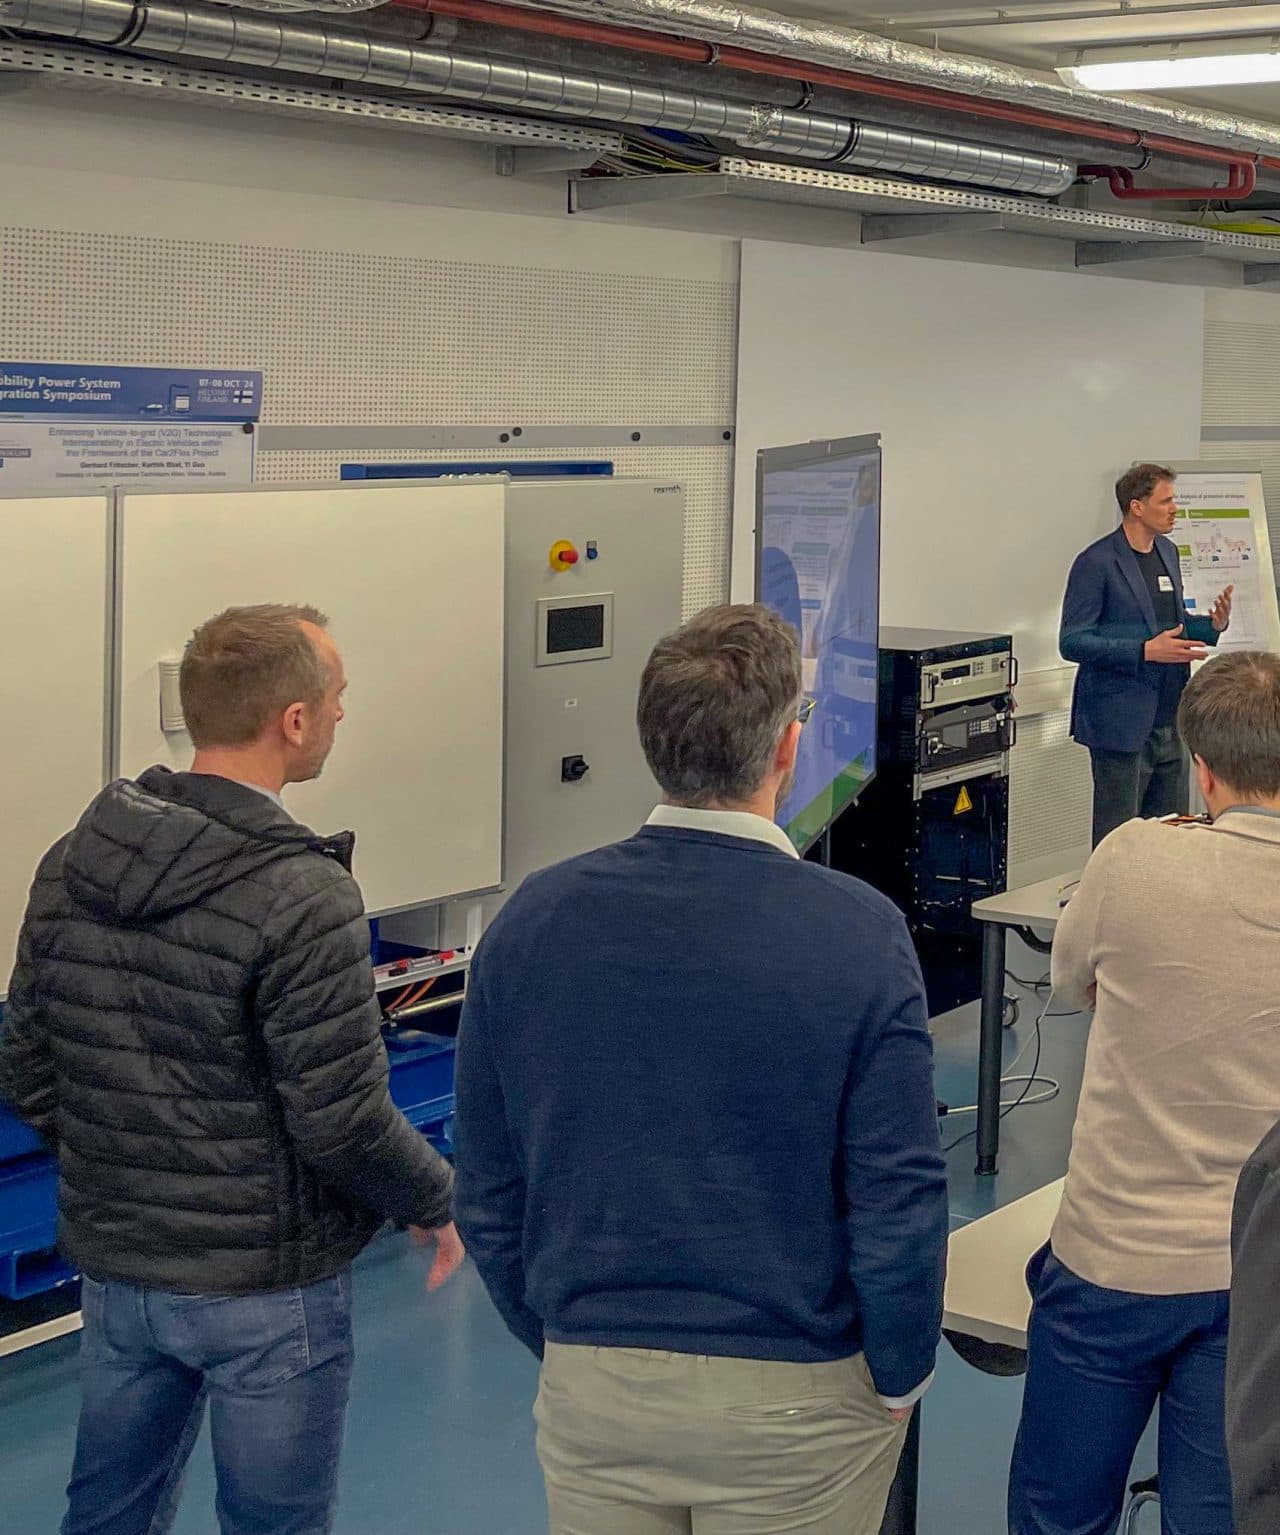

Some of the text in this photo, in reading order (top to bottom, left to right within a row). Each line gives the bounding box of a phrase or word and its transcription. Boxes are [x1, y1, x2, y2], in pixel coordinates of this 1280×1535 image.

[39, 376, 76, 388] Power
[79, 377, 121, 391] System
[224, 379, 240, 388] OCT
[43, 389, 111, 402] Symposium
